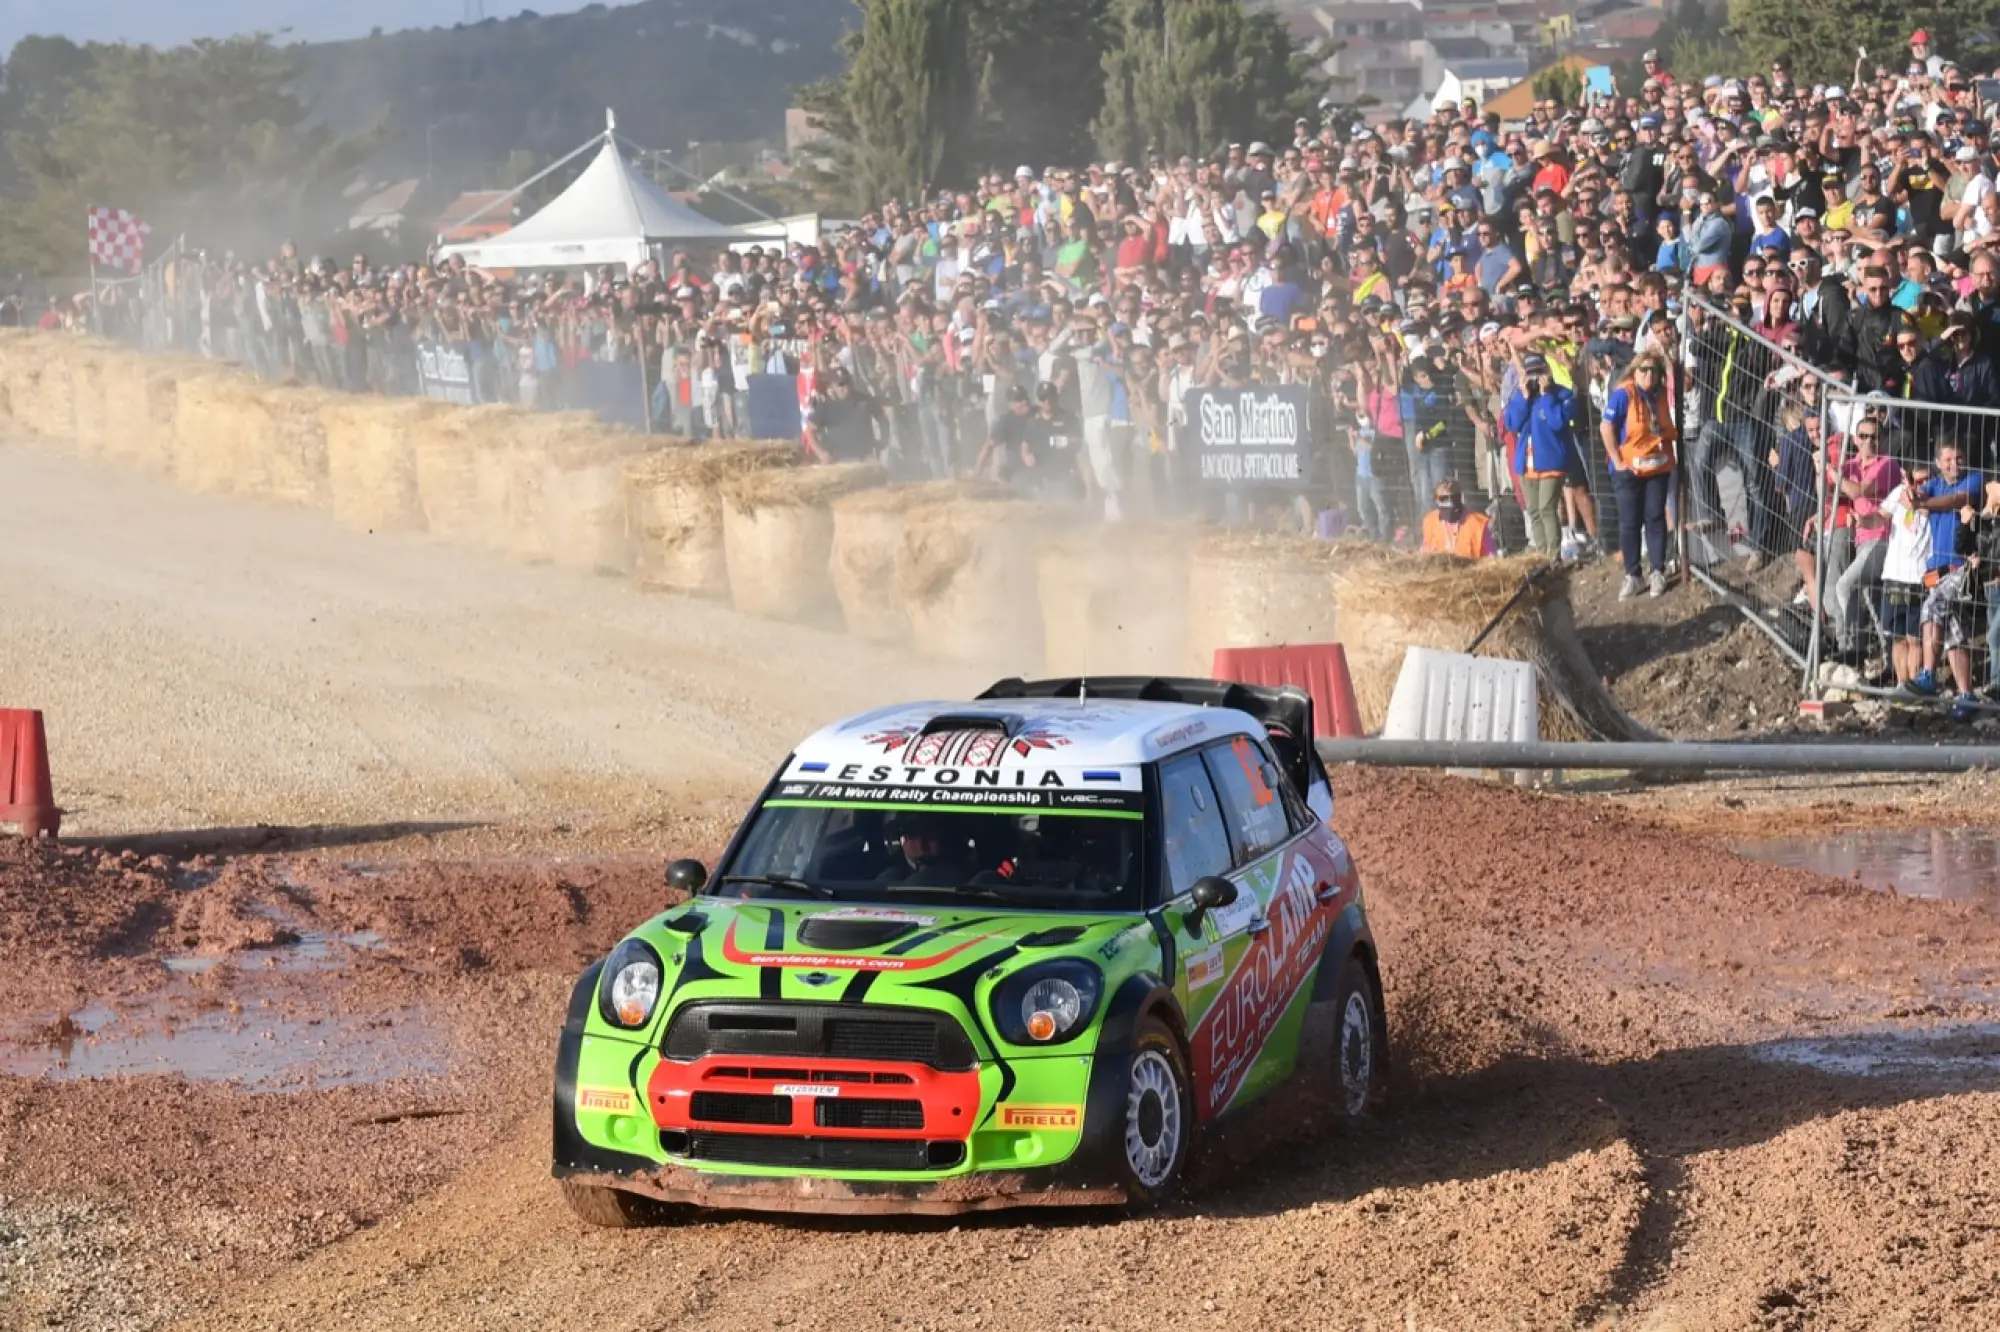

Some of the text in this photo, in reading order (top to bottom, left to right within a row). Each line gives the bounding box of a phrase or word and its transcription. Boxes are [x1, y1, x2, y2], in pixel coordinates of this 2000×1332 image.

[1200, 392, 1297, 445] San Martino
[838, 763, 1065, 787] ESTONIA
[819, 785, 843, 797] FIA
[845, 787, 886, 799] World
[889, 788, 928, 802] Rally
[932, 789, 1040, 804] Championship
[1209, 852, 1318, 1074] EUROLAMP
[581, 1089, 629, 1109] PIRELLI
[1004, 1108, 1076, 1125] PIRELLI
